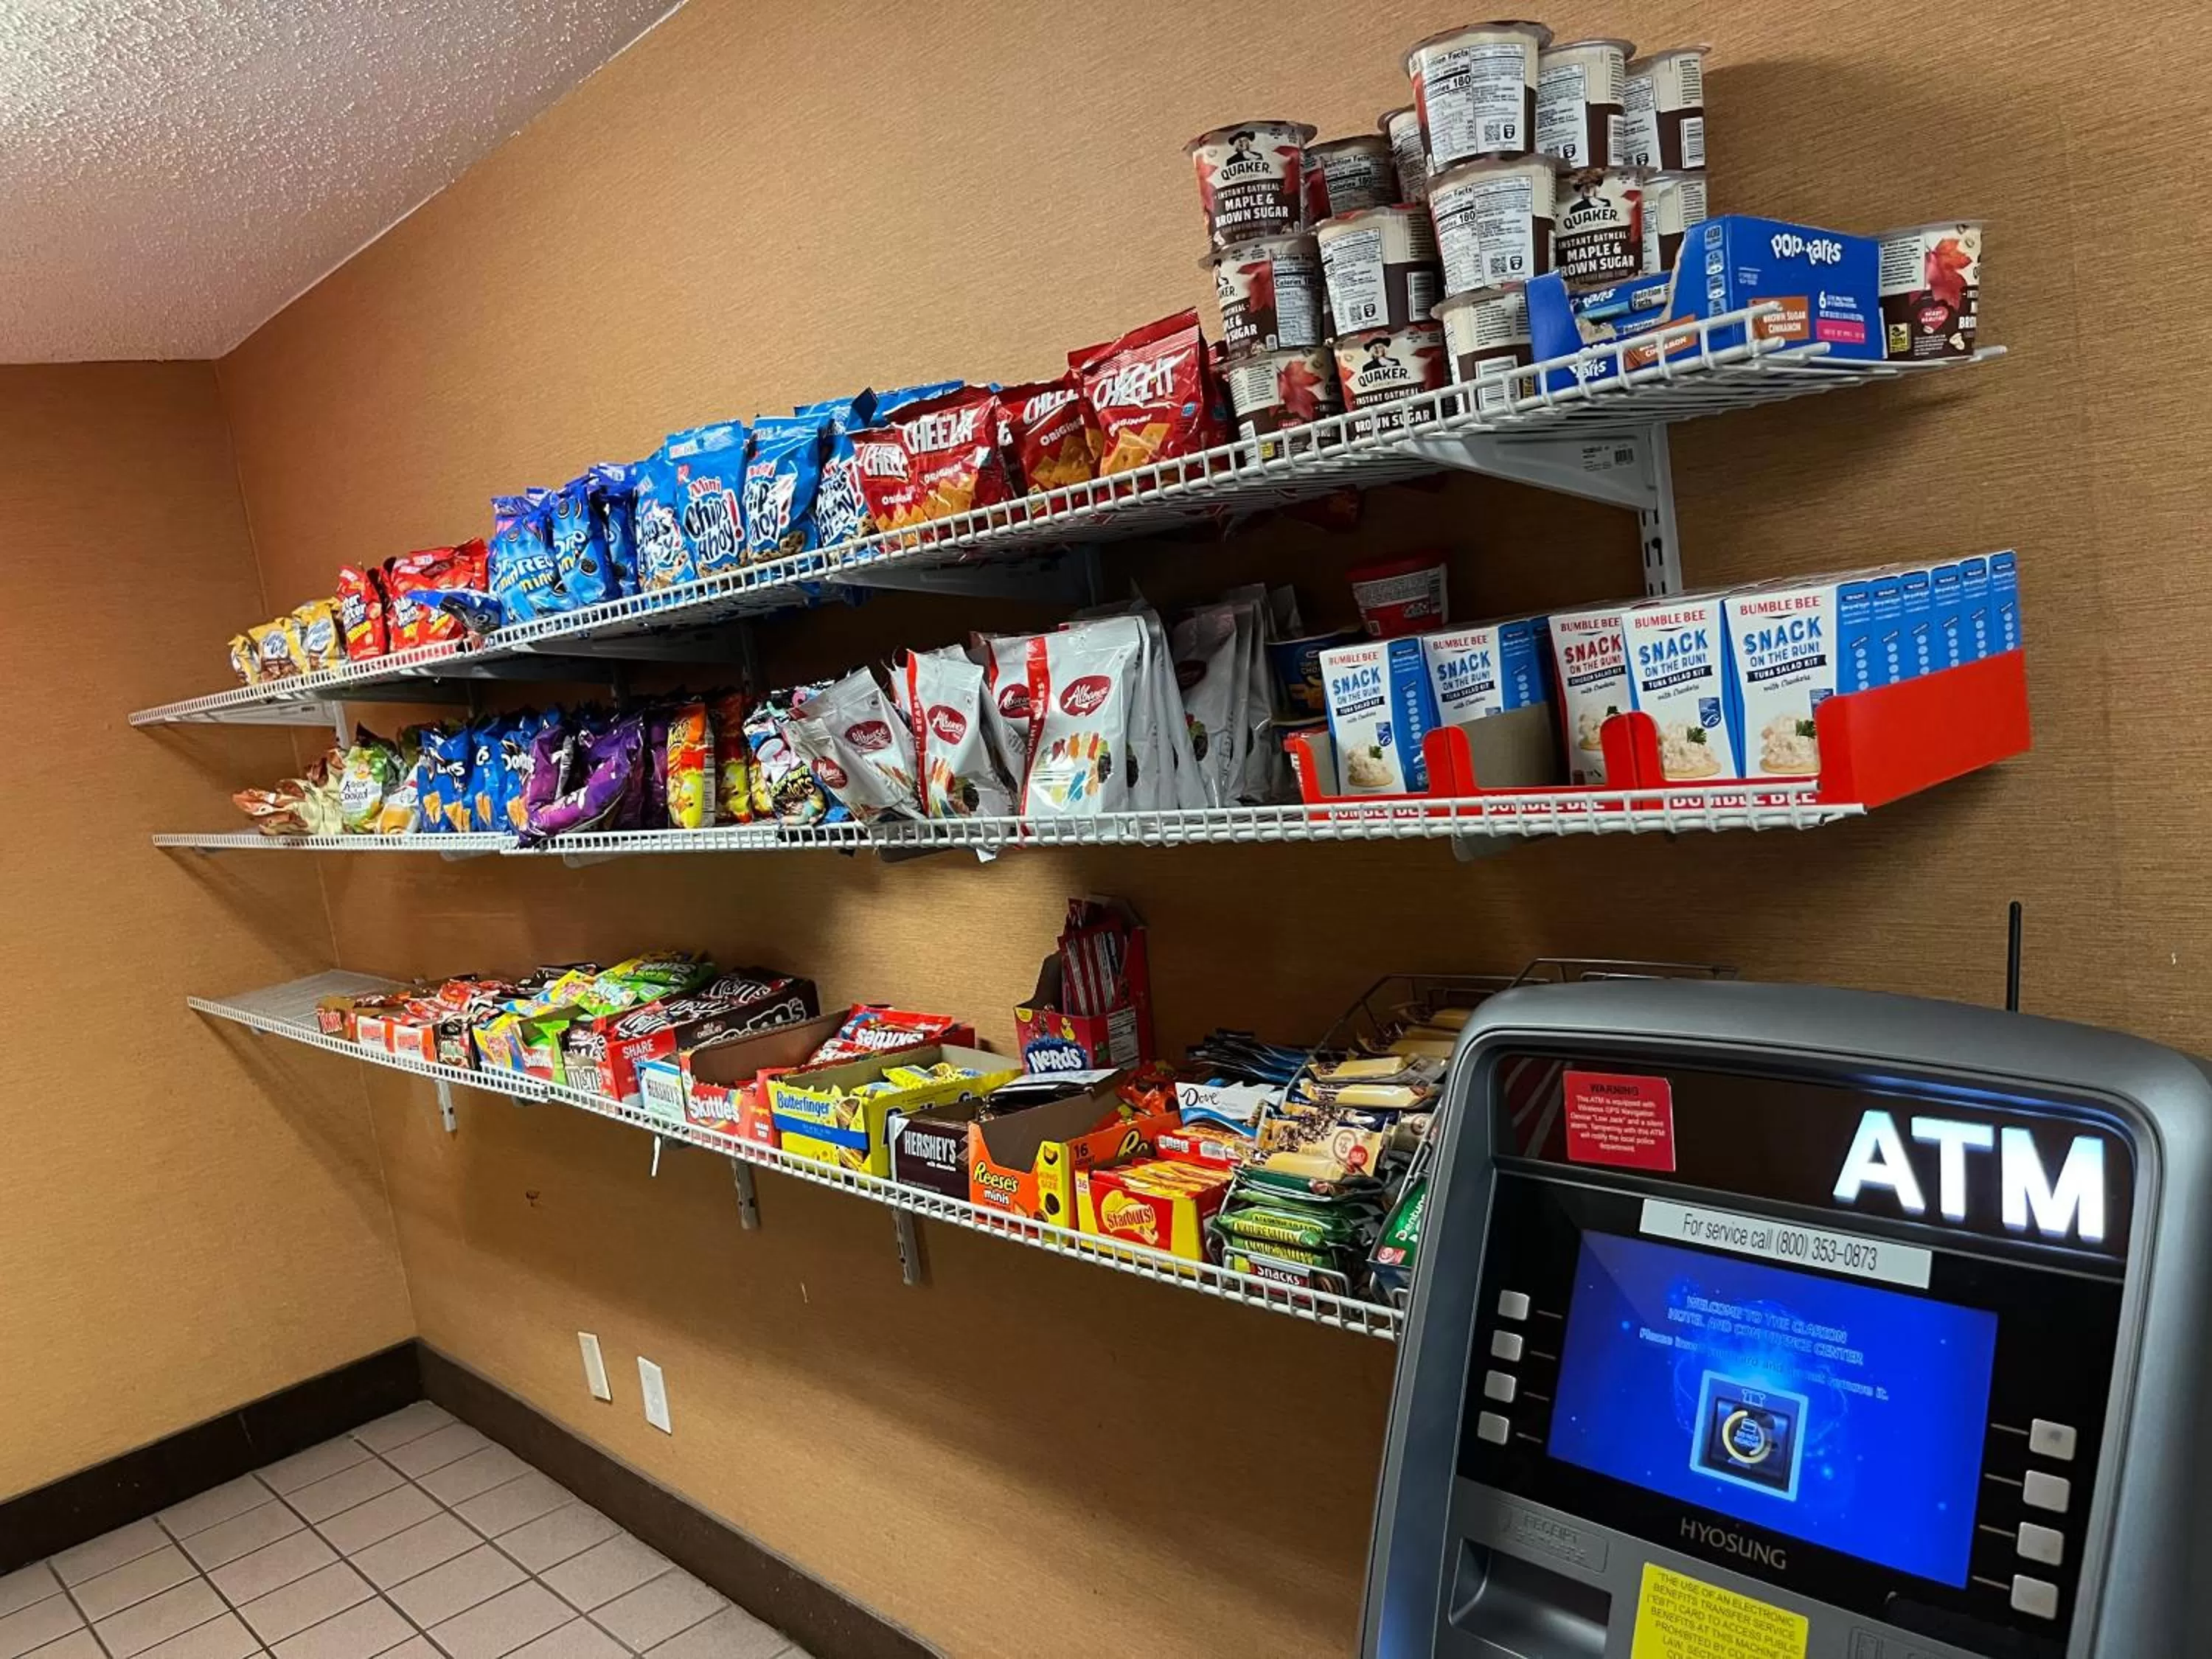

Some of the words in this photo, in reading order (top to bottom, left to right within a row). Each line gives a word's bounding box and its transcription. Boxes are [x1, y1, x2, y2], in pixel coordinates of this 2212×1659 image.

[1453, 74, 1472, 88] 180
[1221, 161, 1273, 181] QUAKER
[1225, 195, 1264, 211] MAPLE
[1266, 193, 1275, 205] &
[1254, 206, 1289, 220] SUGAR
[1563, 209, 1618, 229] QUAKER
[1567, 244, 1610, 262] MAPLE
[1613, 241, 1621, 254] &
[1600, 254, 1635, 270] SUGAR
[1819, 291, 1826, 309] 6
[1357, 368, 1408, 388] QUAKER
[1739, 599, 1792, 616] BUMBLE
[1795, 596, 1821, 608] BEE
[1560, 619, 1599, 633] BUMBLE
[1601, 617, 1621, 627] BEE
[1635, 613, 1682, 629] BUMBLE
[1683, 610, 1706, 622] BEE
[1433, 638, 1470, 650] BUMBLE
[1471, 635, 1488, 645] BEE
[1743, 616, 1823, 655] SNACK
[1563, 633, 1622, 665] SNACK
[1638, 629, 1708, 666] SNACK
[1750, 654, 1767, 667] ON
[1767, 650, 1789, 664] THE
[1790, 641, 1820, 659] RUN!
[1328, 653, 1361, 665] BUMBLE
[1436, 650, 1492, 681] SNACK
[1569, 664, 1582, 675] ON
[1582, 661, 1599, 672] THE
[1645, 665, 1660, 678] ON
[1660, 661, 1679, 674] THE
[1680, 653, 1707, 670] RUN!
[1753, 667, 1775, 680] TUNA
[1775, 661, 1801, 677] SALAD
[1804, 656, 1819, 669] KIT
[1332, 667, 1382, 696] SNACK
[1442, 681, 1453, 691] ON
[1454, 676, 1470, 688] THE
[1649, 678, 1668, 691] TUNA
[1668, 671, 1692, 686] SALAD
[1349, 692, 1363, 703] THE
[622, 1040, 655, 1058] SHARE
[1590, 1085, 1639, 1096] WARNING
[1590, 1096, 1604, 1105] ATM
[687, 1093, 740, 1124] Skittles
[776, 1091, 831, 1117] Butterfinger
[905, 1130, 957, 1164] HERSHEY'S
[1074, 1144, 1089, 1158] 16
[974, 1161, 1019, 1193] Reese's
[1832, 1109, 2104, 1243] ATM
[983, 1189, 1010, 1205] minis
[1683, 1213, 1702, 1235] For
[1705, 1221, 1748, 1247] service
[1750, 1230, 1773, 1250] call
[1775, 1231, 1809, 1259] (800)
[1812, 1237, 1878, 1271] 353-0873
[1256, 1266, 1301, 1286] Snacks
[1680, 1517, 1788, 1571] HYOSUNG
[1652, 1582, 1698, 1607] BENEFITS
[1700, 1596, 1753, 1625] TRANSFER
[1753, 1615, 1795, 1641] SERVICE
[1680, 1579, 1700, 1595] USE
[1701, 1587, 1714, 1599] OF
[1715, 1590, 1731, 1606] AN
[1731, 1596, 1795, 1627] ELECTRONIC
[1651, 1606, 1696, 1630] BENEFITS
[1697, 1623, 1710, 1635] AT
[1712, 1627, 1734, 1644] THIS
[1678, 1603, 1706, 1621] CARD
[1708, 1614, 1722, 1626] TO
[1722, 1620, 1761, 1641] ACCESS
[1762, 1635, 1800, 1656] PUBLIC
[1654, 1620, 1712, 1649] PROHIBITED
[1712, 1641, 1726, 1654] BY
